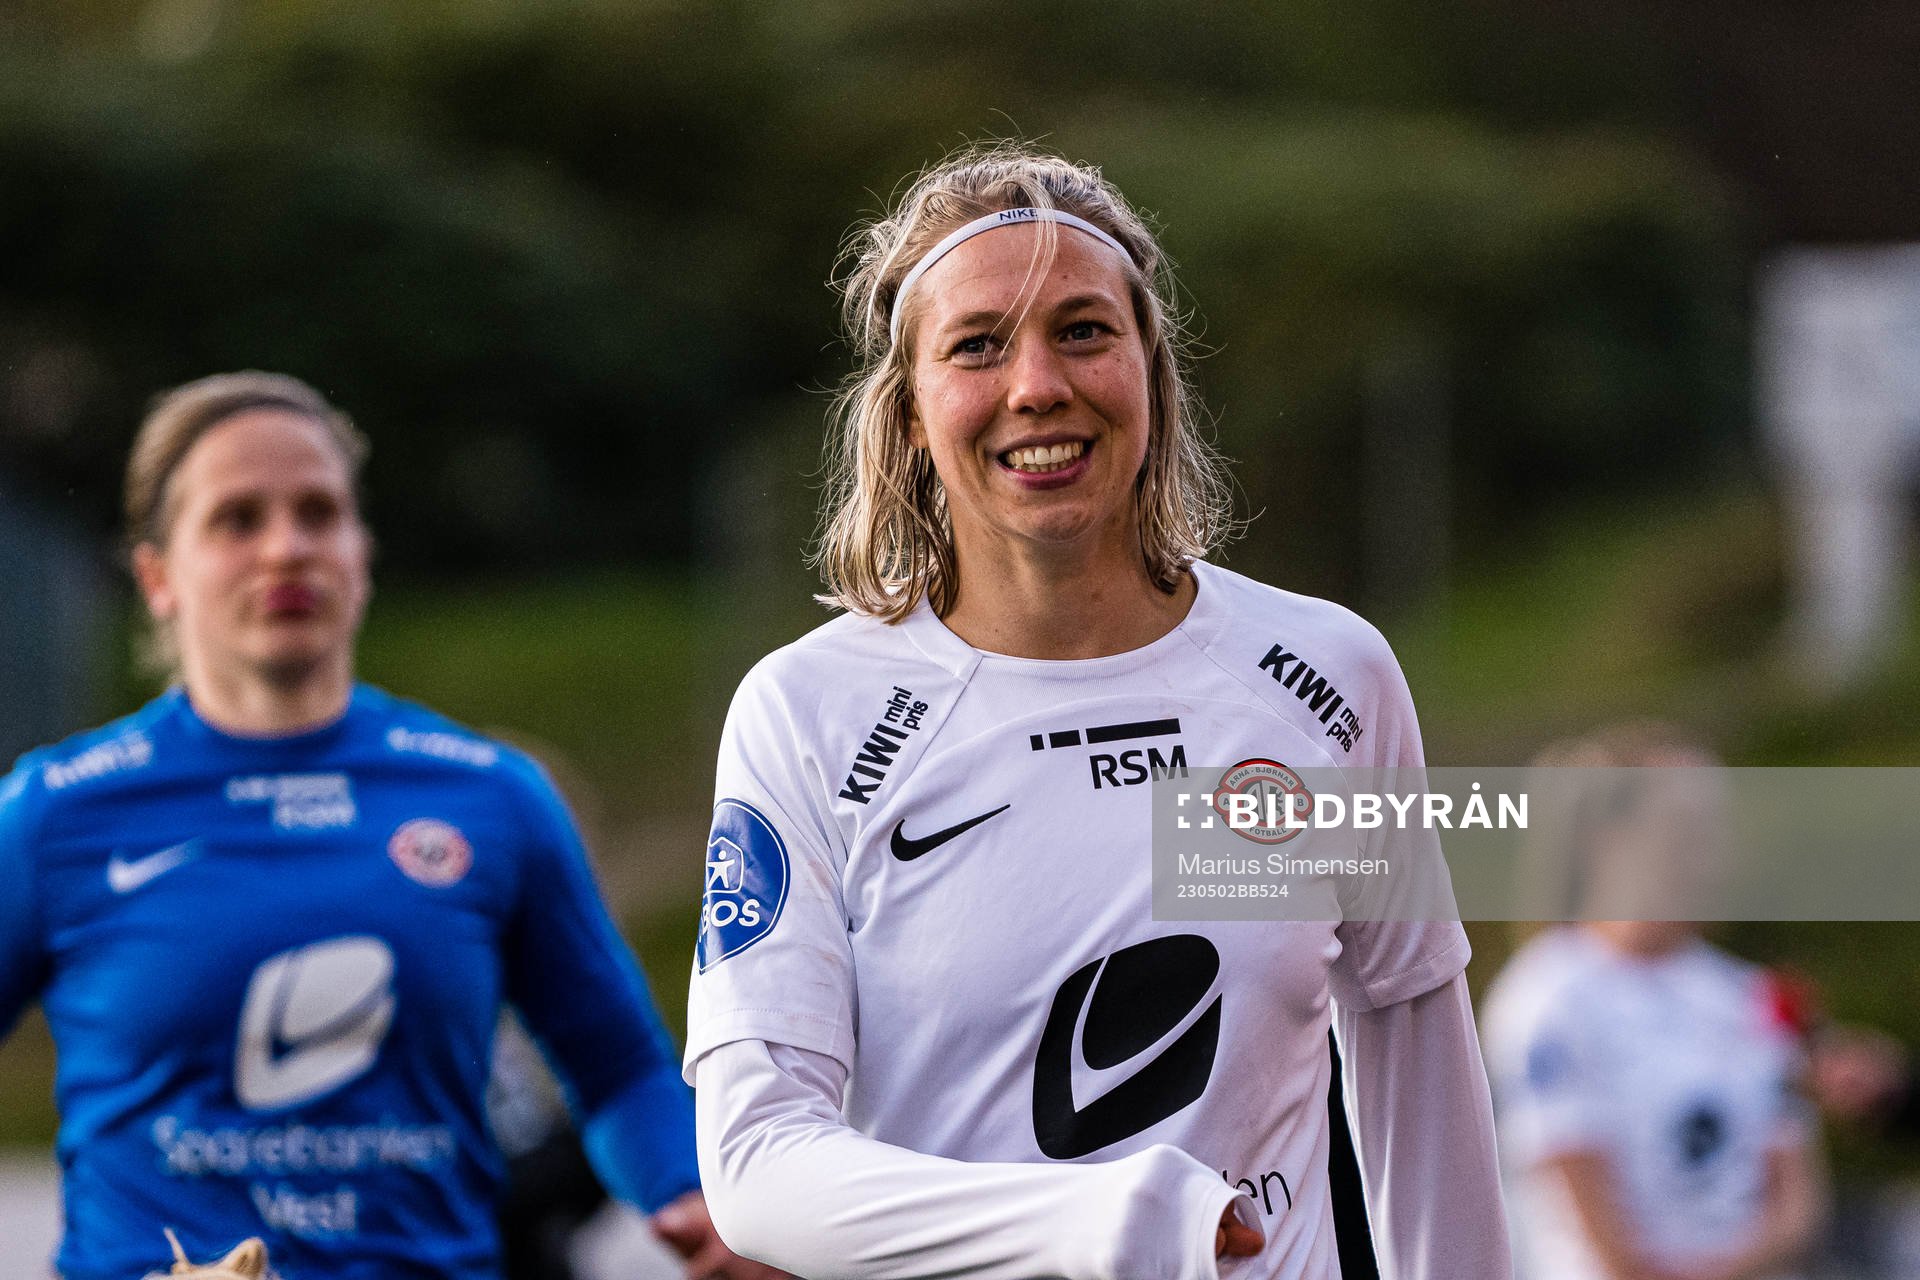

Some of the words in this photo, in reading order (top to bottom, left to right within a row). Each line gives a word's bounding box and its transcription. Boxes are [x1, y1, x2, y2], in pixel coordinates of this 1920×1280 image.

[999, 208, 1038, 221] NIKE
[1257, 643, 1344, 725] KIWI
[884, 686, 912, 723] mini
[902, 700, 928, 731] pris
[1325, 721, 1353, 753] pris
[1340, 706, 1363, 743] mini
[838, 722, 909, 805] KIWI
[1089, 744, 1189, 790] RSM
[1229, 769, 1250, 787] ARNA
[1255, 766, 1295, 787] BJØRNAR
[1249, 826, 1288, 837] FOTBALL
[700, 898, 761, 944] BOS
